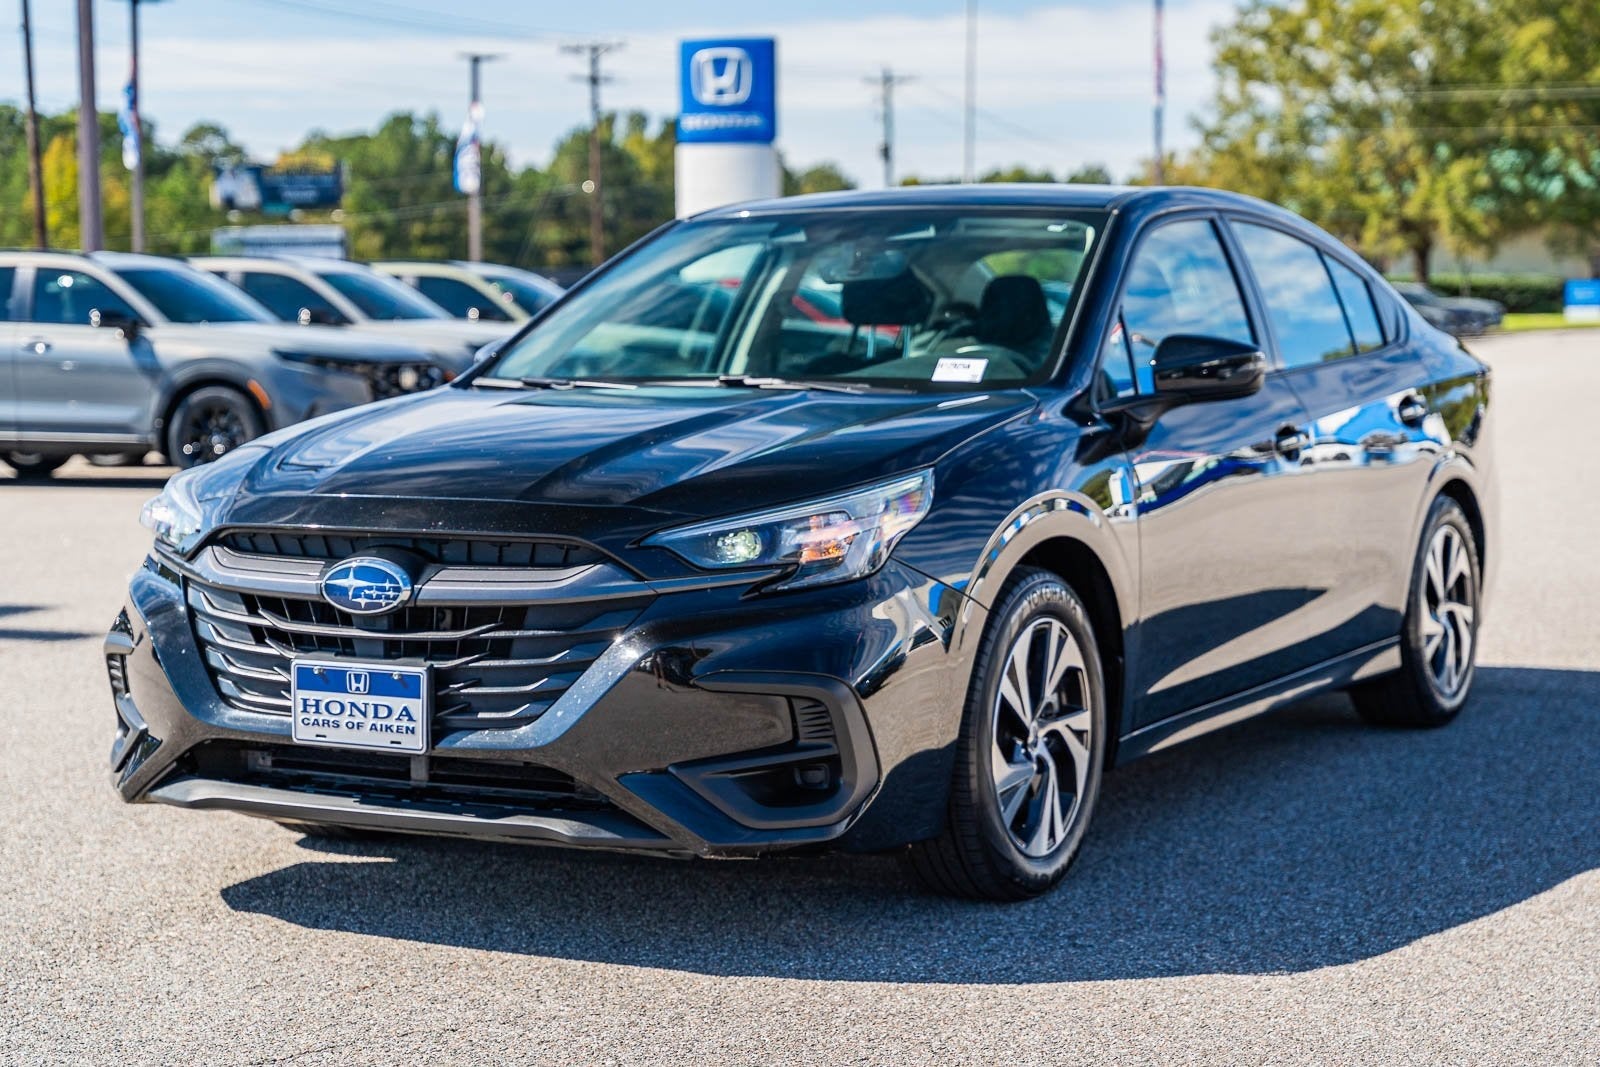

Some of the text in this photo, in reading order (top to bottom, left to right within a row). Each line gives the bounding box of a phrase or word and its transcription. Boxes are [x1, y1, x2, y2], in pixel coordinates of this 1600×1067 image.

[300, 697, 416, 722] HONDA
[301, 717, 415, 735] CARS OF AIKEN
